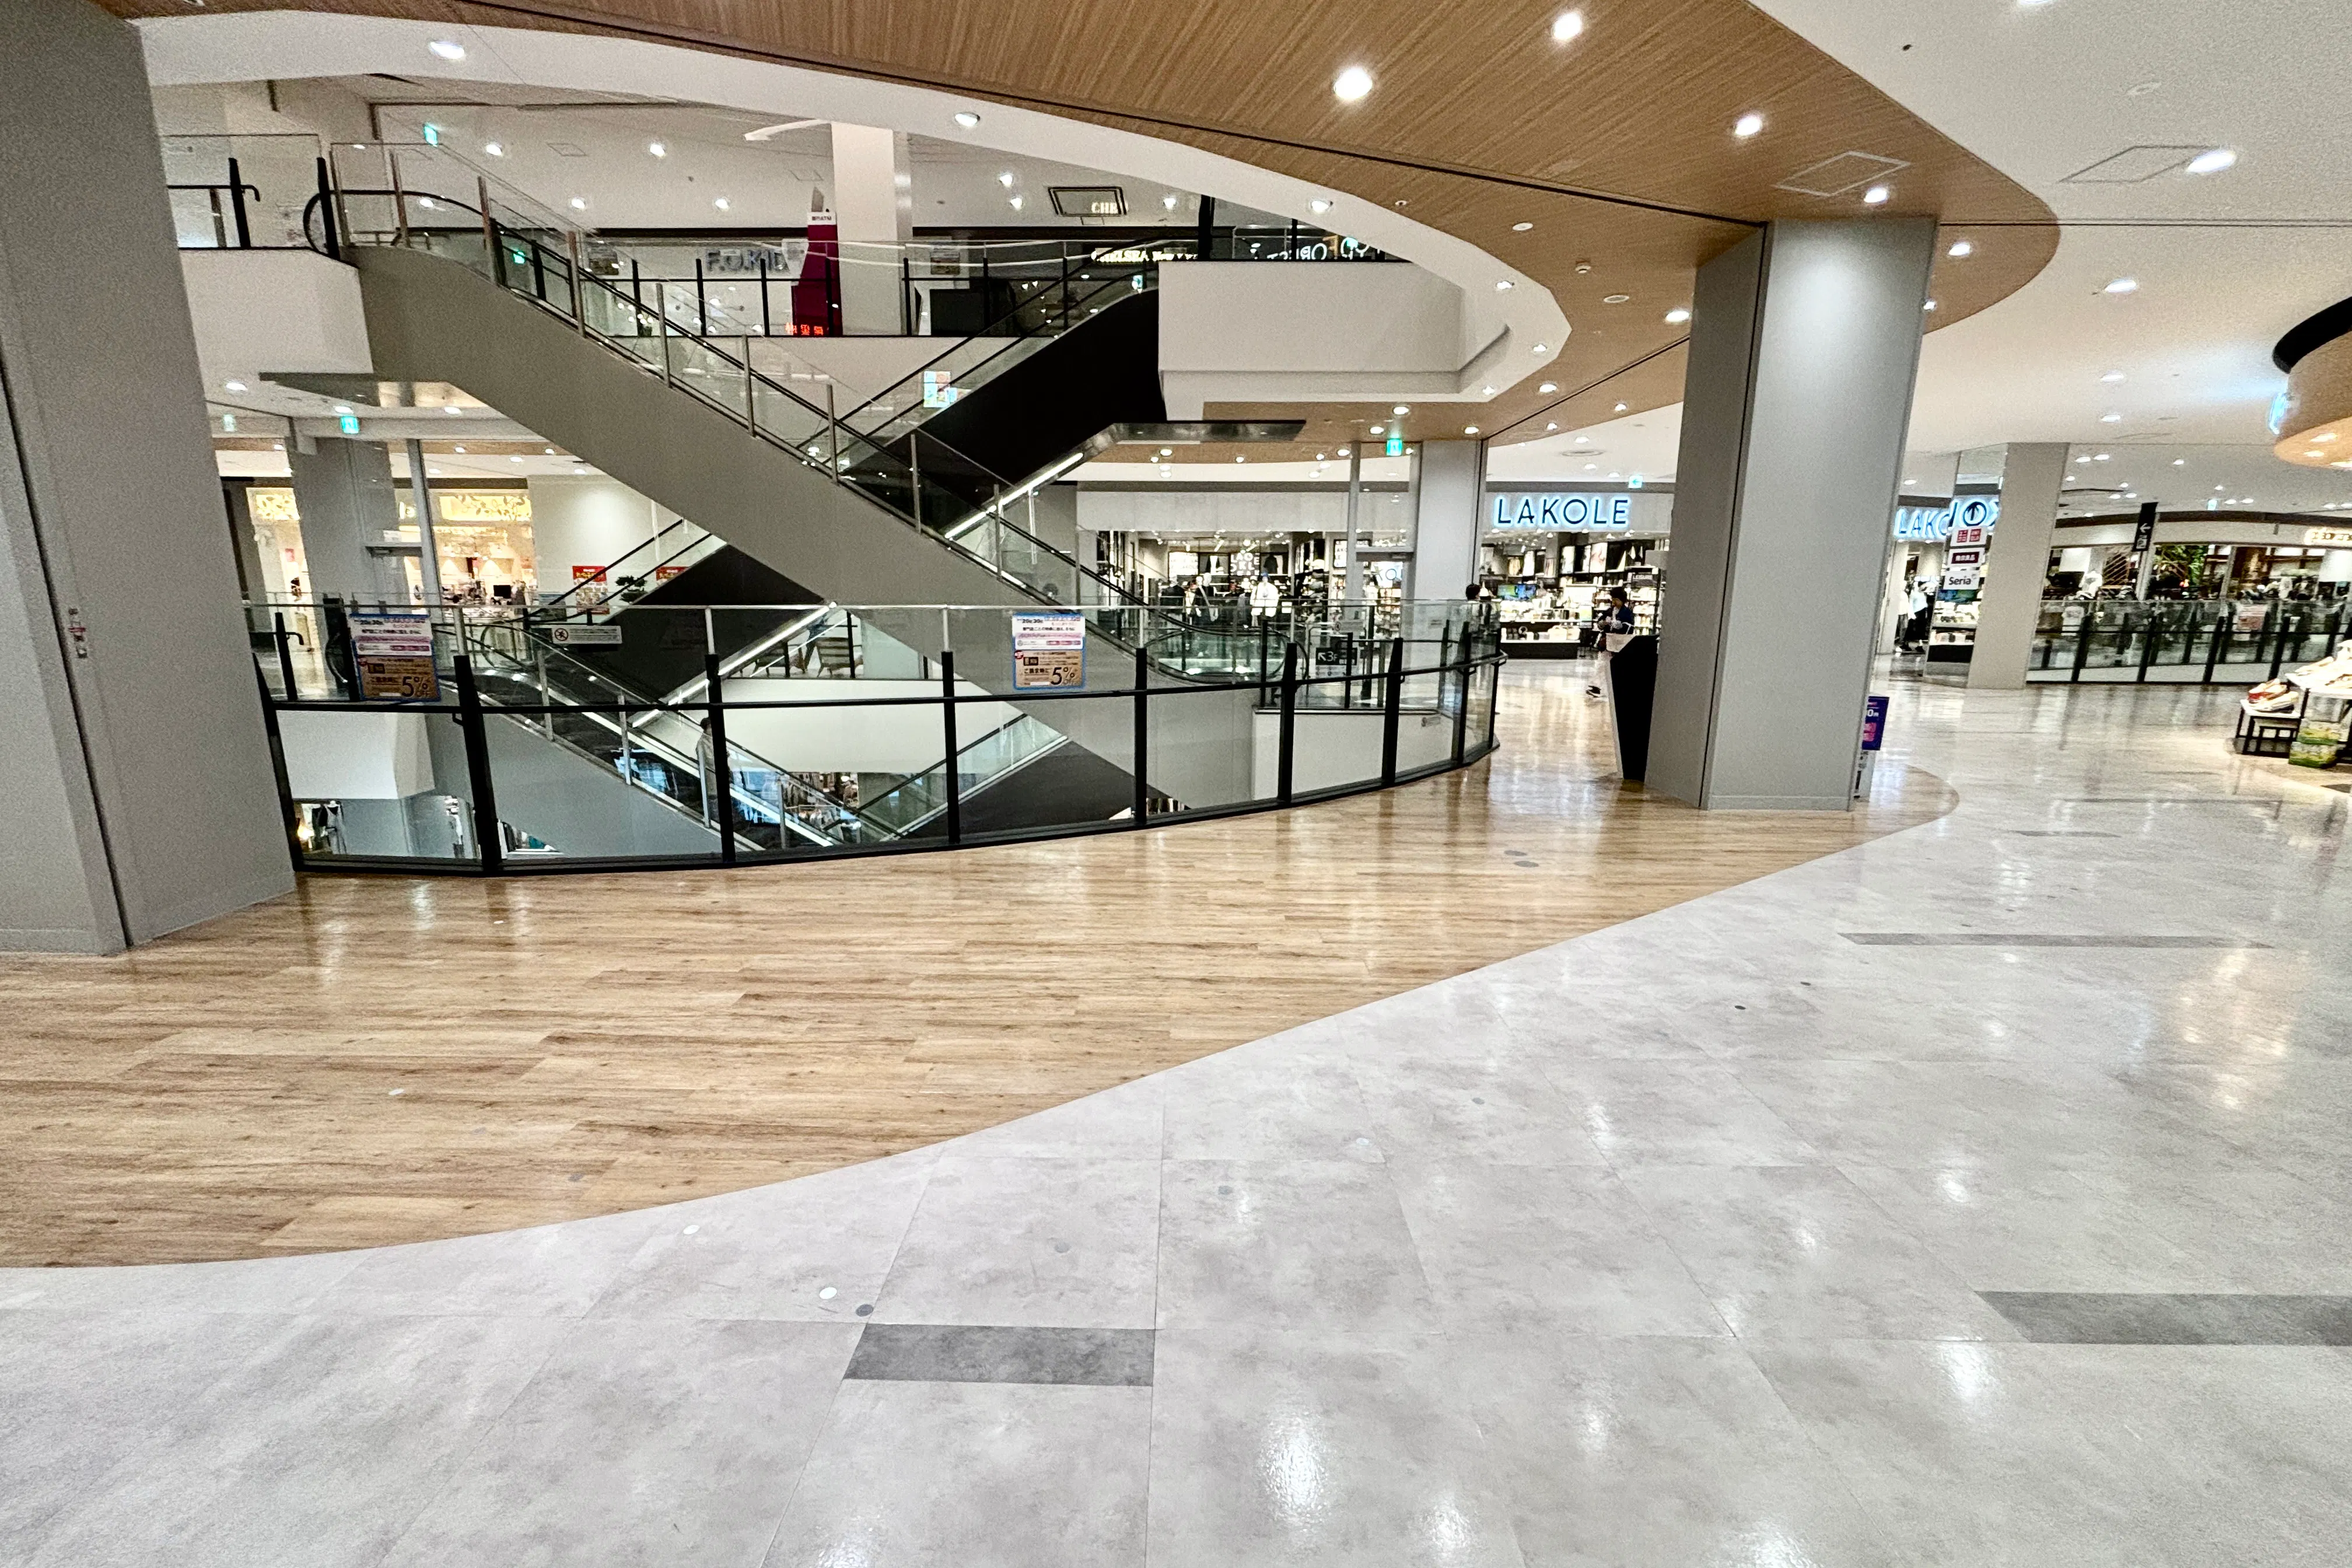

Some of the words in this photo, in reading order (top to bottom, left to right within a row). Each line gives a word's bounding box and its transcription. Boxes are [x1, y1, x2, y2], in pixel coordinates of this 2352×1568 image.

[1496, 496, 1631, 526] LAKOLE
[1948, 575, 1972, 586] Seria
[1051, 667, 1075, 685] 5%
[401, 676, 429, 697] 5%
